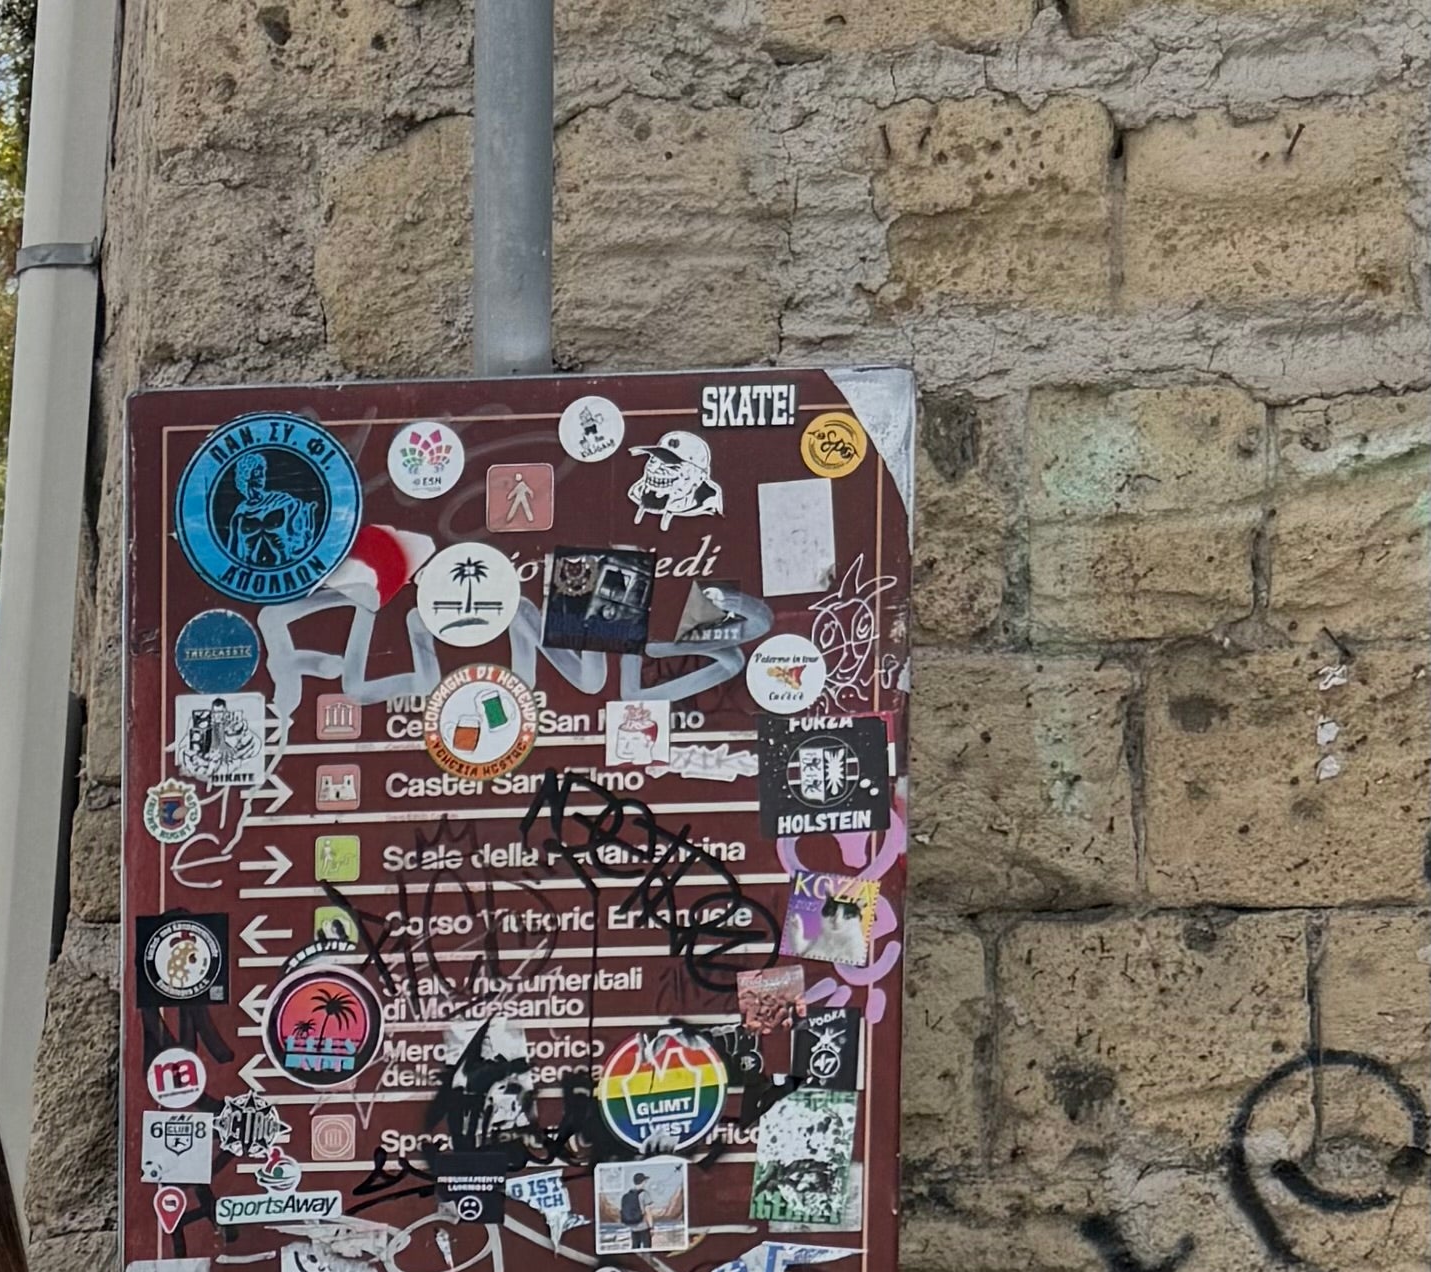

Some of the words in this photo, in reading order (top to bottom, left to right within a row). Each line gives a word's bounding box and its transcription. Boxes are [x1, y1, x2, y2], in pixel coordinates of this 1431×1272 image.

[702, 384, 796, 427] SKATE!
[681, 628, 742, 641] ANDIT
[539, 711, 590, 733] San
[777, 809, 873, 836] HOLSTEIN
[809, 1008, 847, 1028] VODKA
[813, 1052, 838, 1074] 47
[636, 1096, 692, 1117] GLIMT
[150, 1121, 163, 1139] 6
[194, 1121, 207, 1139] 8
[218, 1194, 339, 1222] SportsAway
